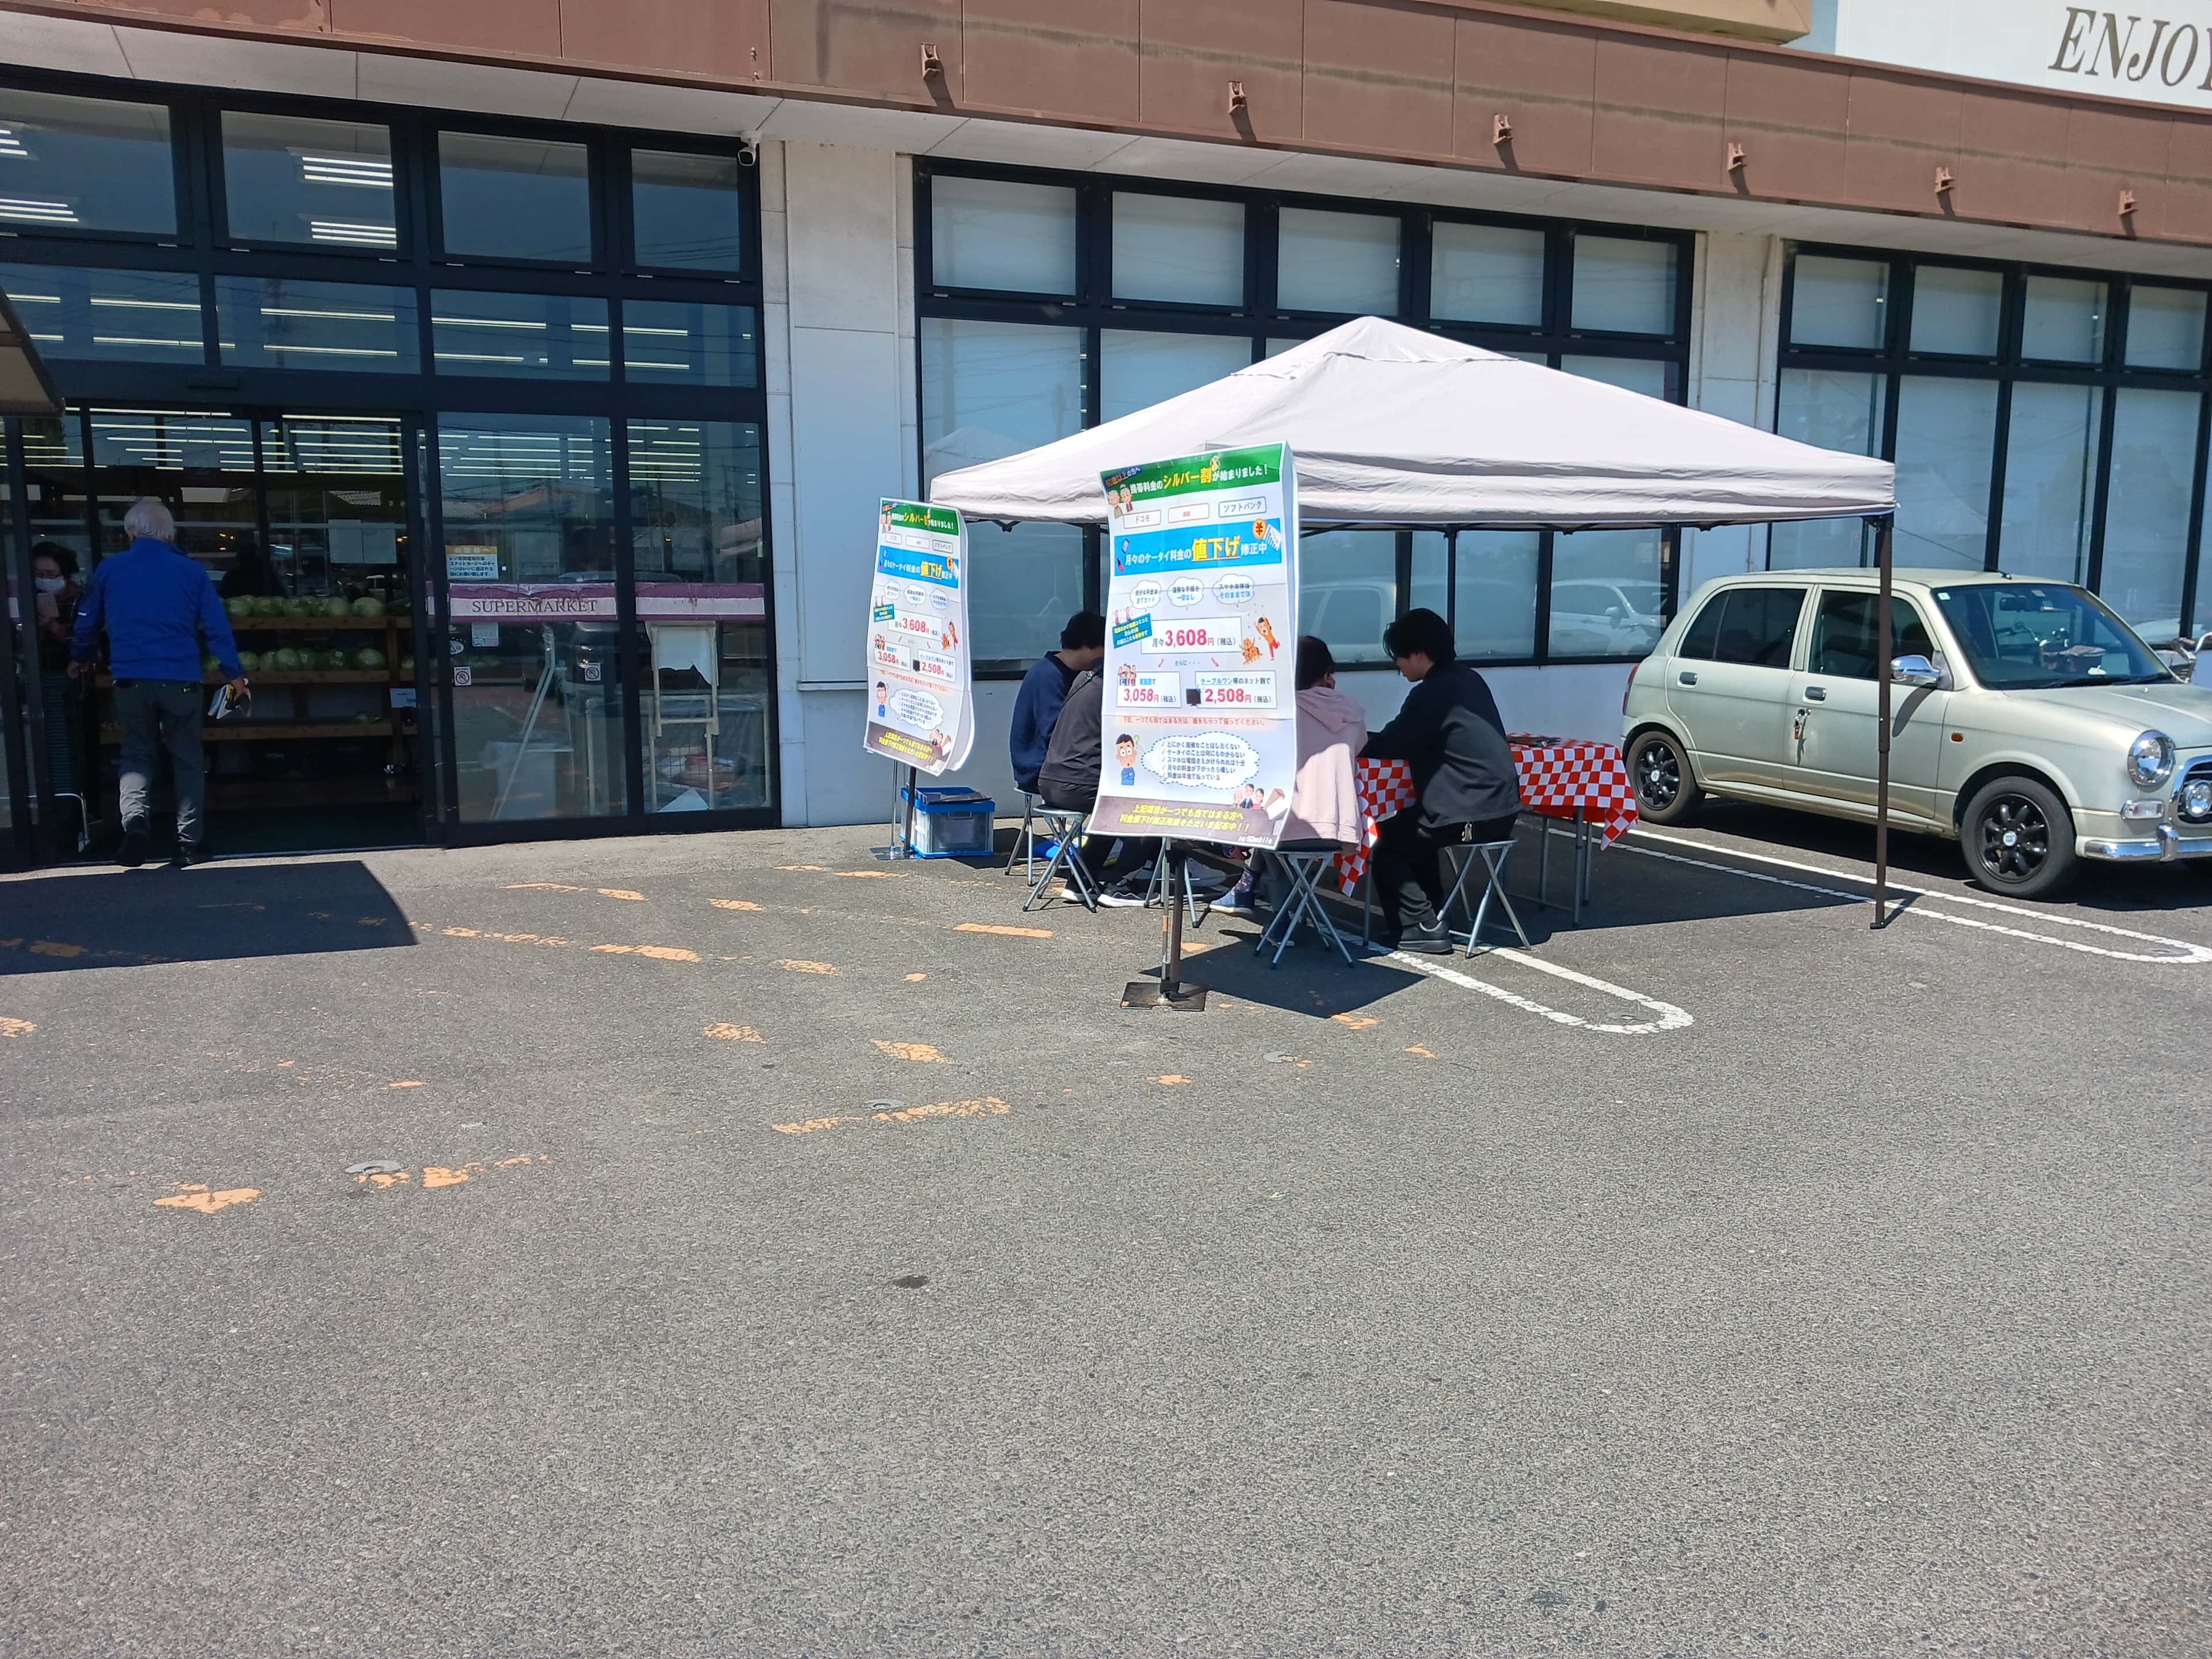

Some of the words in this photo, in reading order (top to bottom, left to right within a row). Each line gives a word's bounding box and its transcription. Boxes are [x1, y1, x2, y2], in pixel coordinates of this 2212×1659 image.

[1224, 501, 1262, 513] ソフトバンク
[1135, 514, 1150, 524] ドコモ
[472, 600, 597, 613] SUPERMARKET
